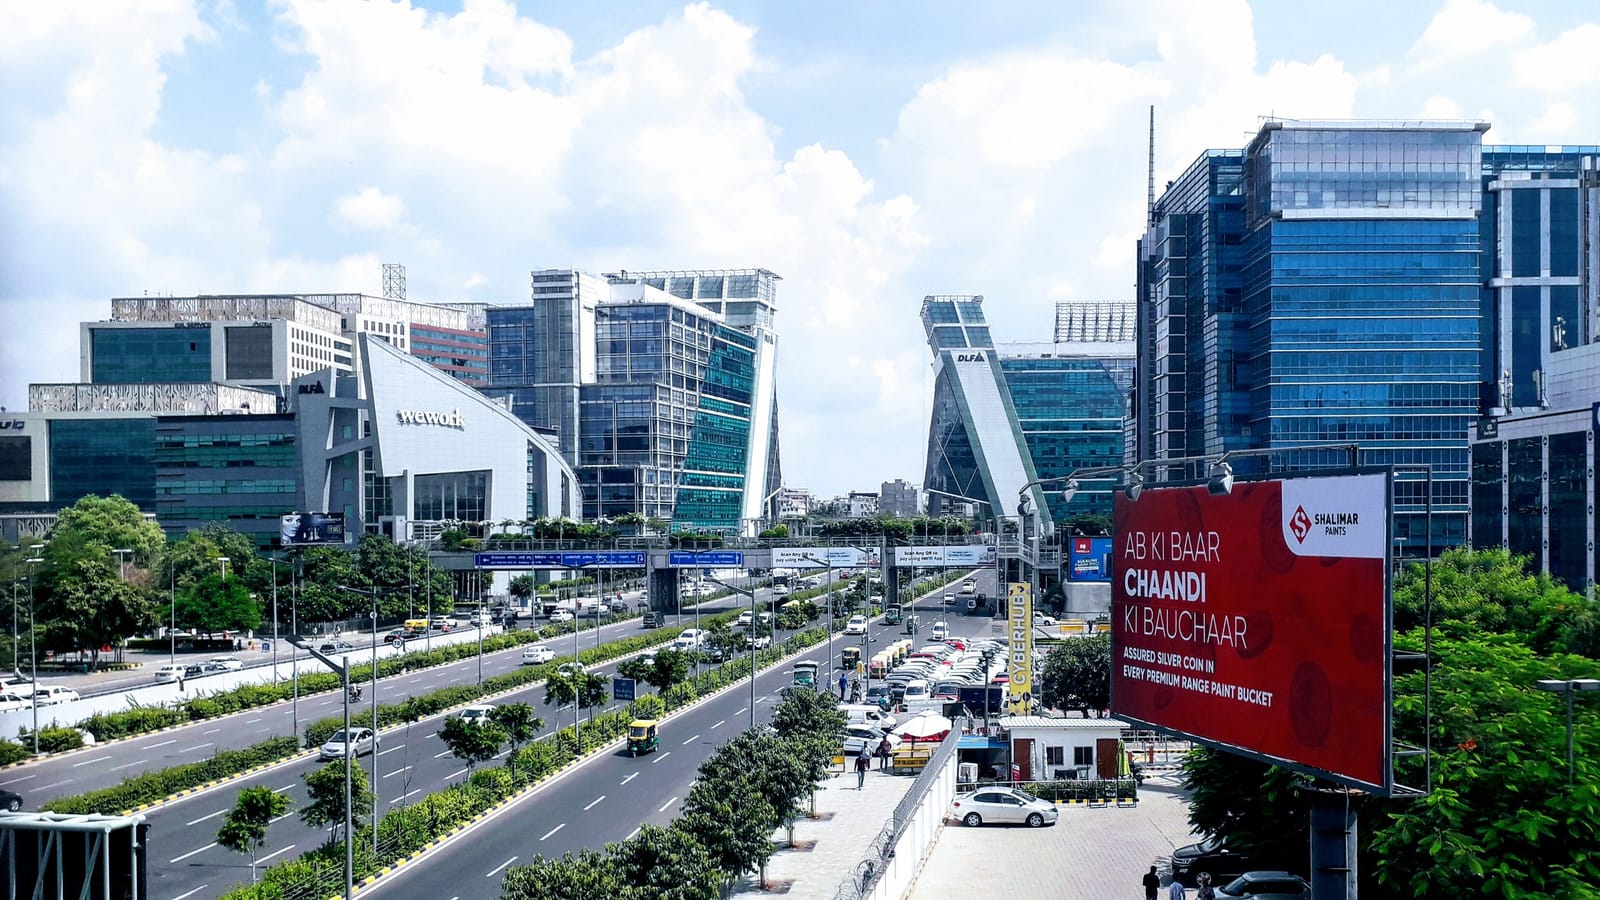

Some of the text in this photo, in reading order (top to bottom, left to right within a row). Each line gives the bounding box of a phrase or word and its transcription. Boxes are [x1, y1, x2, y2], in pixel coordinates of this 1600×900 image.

[957, 354, 976, 362] DLF
[398, 408, 466, 429] wework
[1314, 512, 1359, 526] SHALIMAR
[1325, 525, 1347, 536] PAINTS
[1124, 531, 1220, 562] AB KI BAAR
[1124, 568, 1205, 602] CHAANDI
[1012, 594, 1027, 686] CYBERHUB
[1124, 605, 1248, 649] KI BAUCHAAR
[1123, 646, 1215, 674] ASSURED SILVER COIN IN
[1123, 665, 1273, 707] EVERY PREMIUM RANGE PAINT BUCKET
